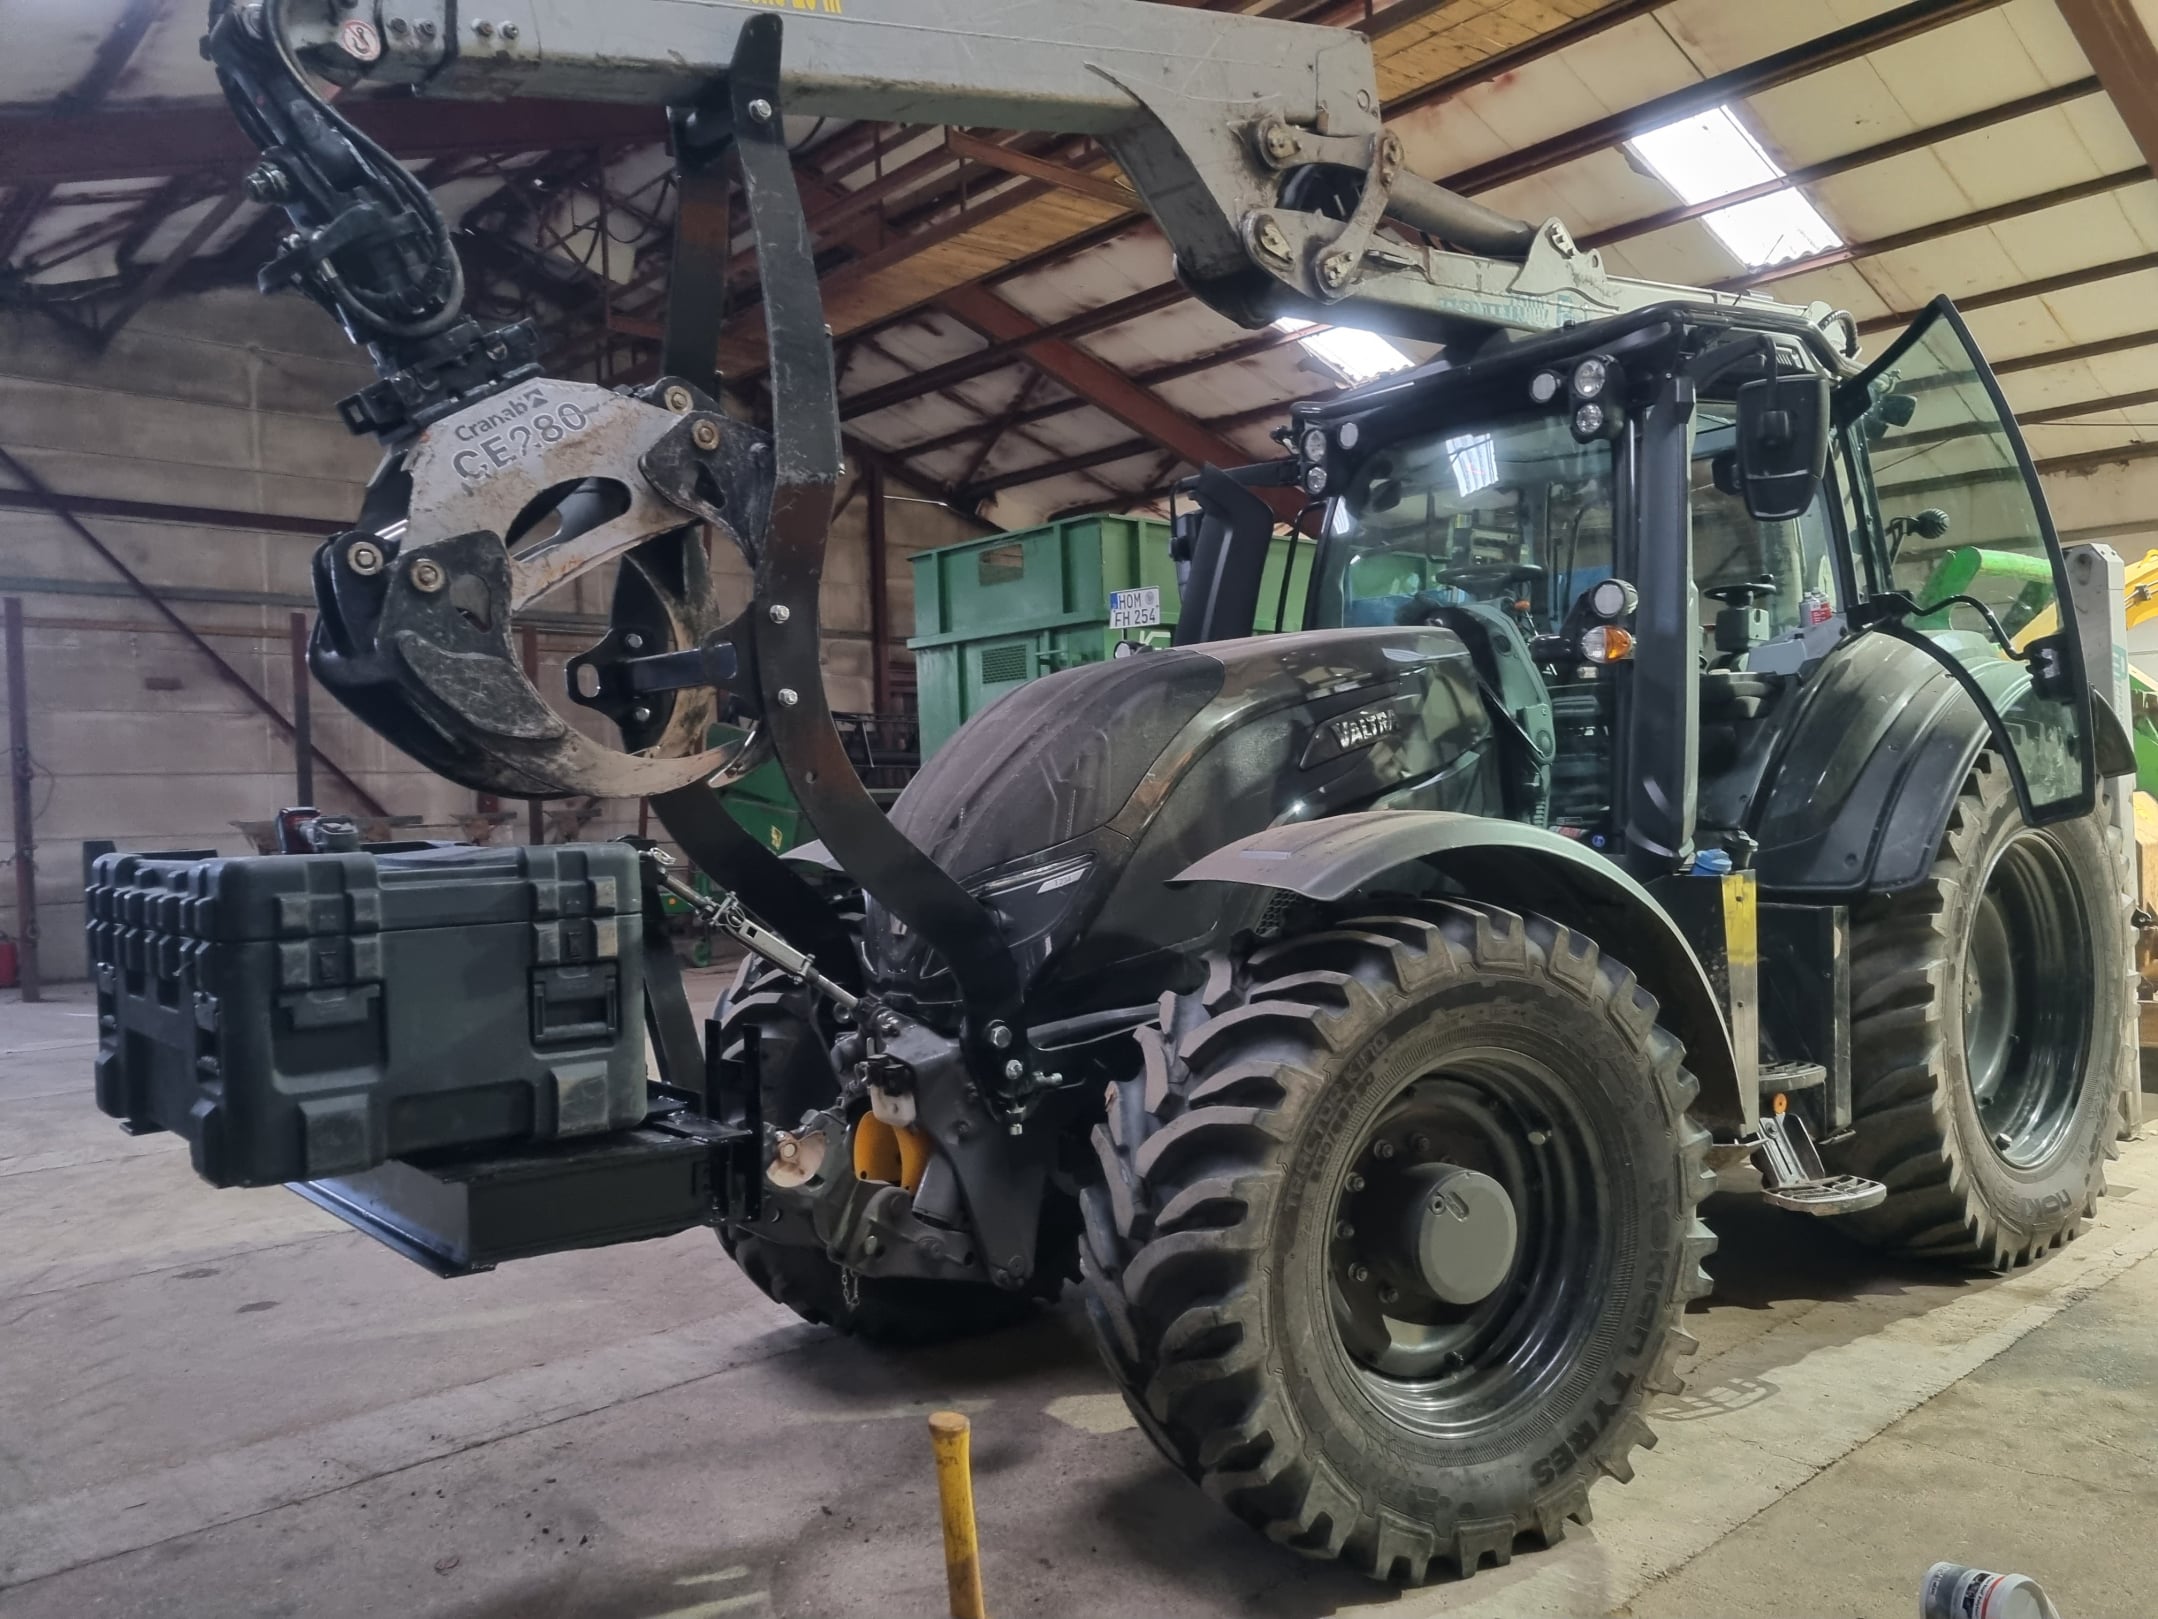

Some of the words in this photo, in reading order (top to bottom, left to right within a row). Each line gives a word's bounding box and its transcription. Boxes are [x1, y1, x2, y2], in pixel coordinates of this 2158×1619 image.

[452, 402, 587, 480] CE280
[454, 399, 529, 441] Cranab
[1114, 610, 1130, 627] FH
[1134, 607, 1156, 625] 254
[1118, 592, 1142, 610] HOM
[1530, 1370, 1636, 1488] TYRES
